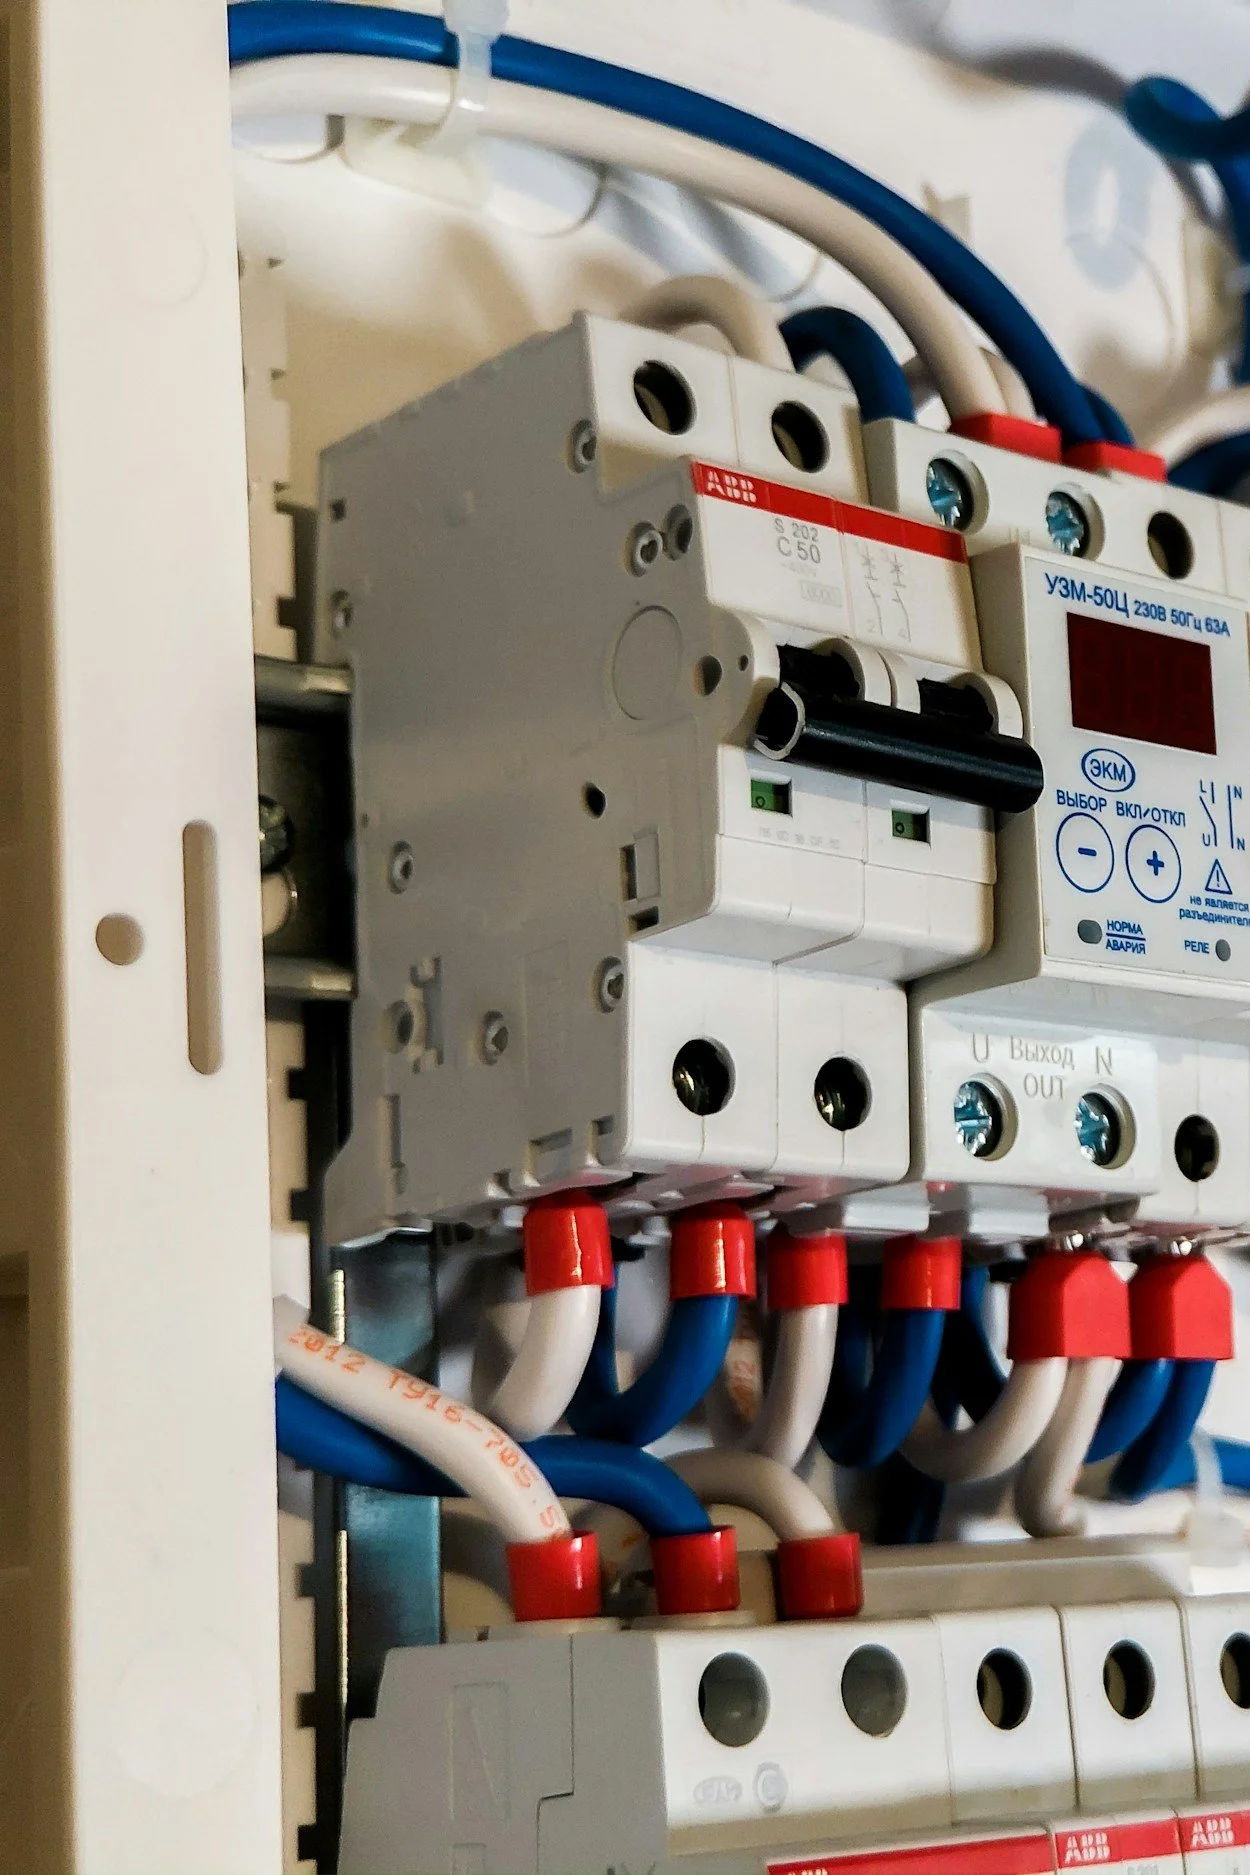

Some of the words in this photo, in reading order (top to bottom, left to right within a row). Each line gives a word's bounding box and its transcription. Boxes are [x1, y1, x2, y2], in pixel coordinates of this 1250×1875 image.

[707, 470, 757, 504] ABB
[792, 522, 819, 544] 202
[1044, 572, 1130, 618] УЗМ-50Ц
[1134, 600, 1167, 622] 230В
[1171, 609, 1202, 633] 50Гц
[1089, 757, 1127, 783] ЭКМ
[1056, 788, 1108, 812] ВЫБОР
[1116, 801, 1186, 828] ВКЛ/ОТКЛ
[1189, 895, 1202, 906] не
[1204, 897, 1250, 913] является
[1106, 919, 1144, 936] НОРМА
[1105, 938, 1146, 955] АВАРИЯ
[1184, 939, 1210, 954] РЕЛЕ
[1010, 1035, 1076, 1070] Выход
[1095, 1045, 1113, 1076] N
[1023, 1072, 1068, 1100] OUT
[1191, 1817, 1235, 1848] ABB
[1064, 1831, 1111, 1864] ABB
